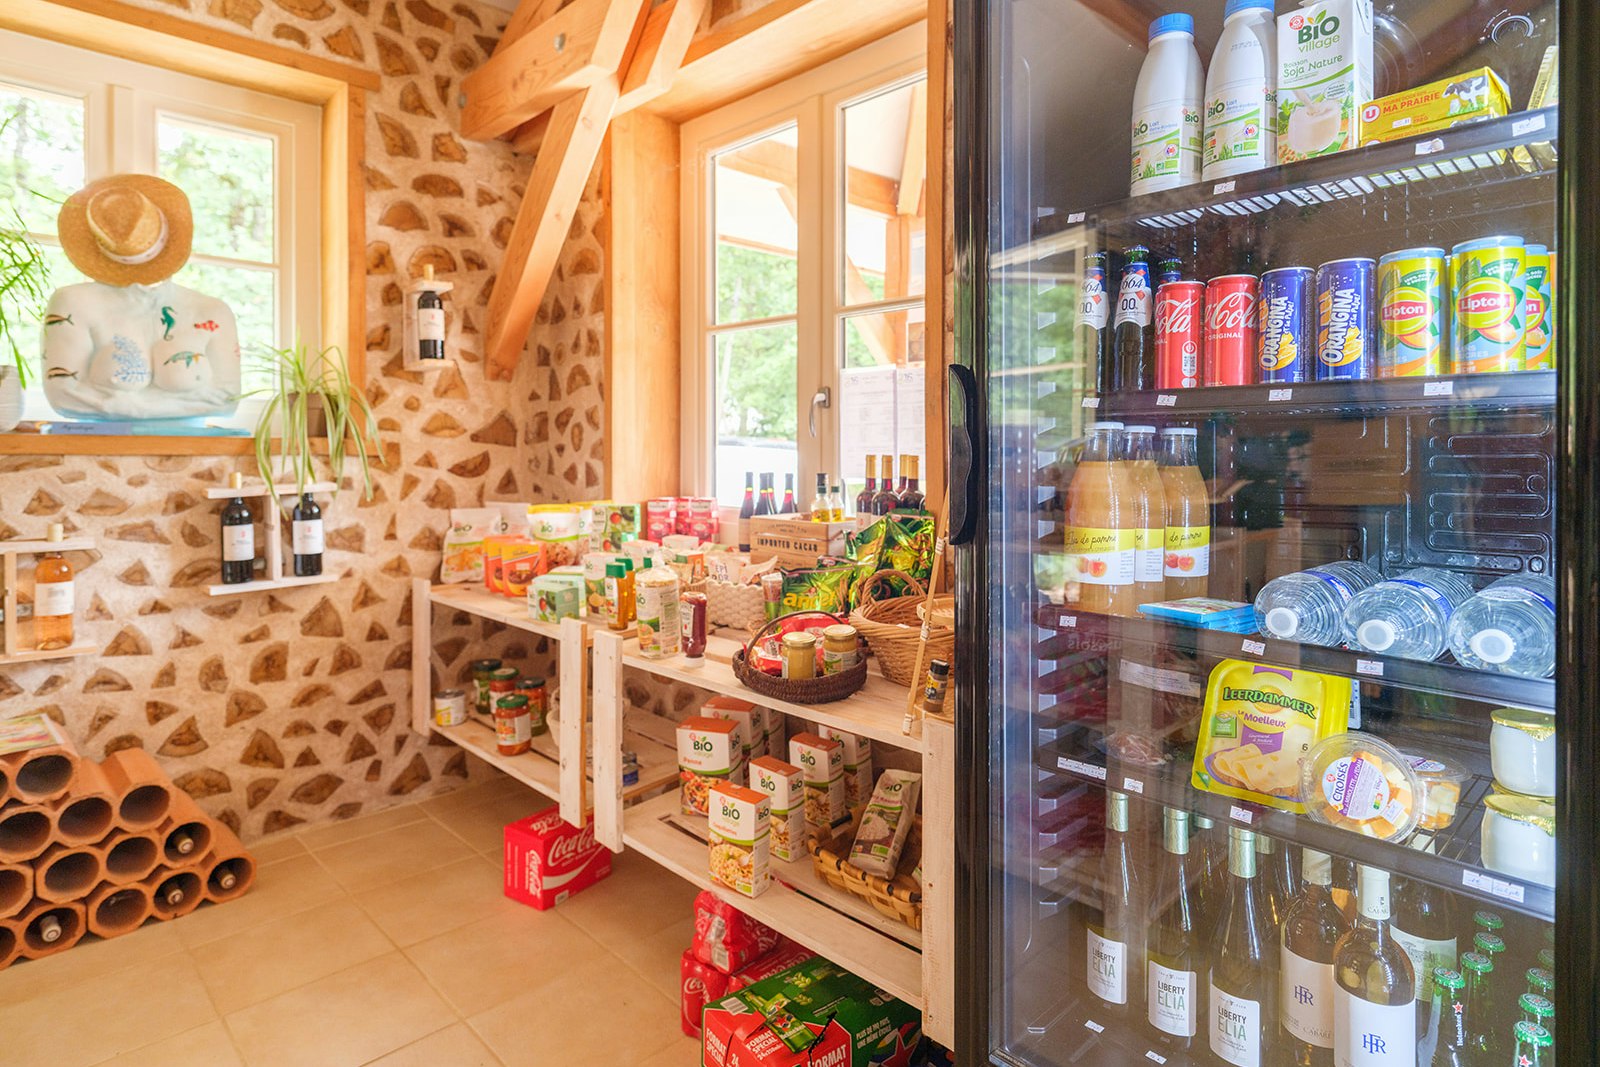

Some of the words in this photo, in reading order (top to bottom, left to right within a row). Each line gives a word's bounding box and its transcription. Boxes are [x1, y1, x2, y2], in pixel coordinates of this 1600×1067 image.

[1299, 34, 1340, 53] village
[1284, 67, 1305, 78] Soja
[1308, 54, 1343, 71] Nature
[1383, 104, 1398, 114] MA
[1401, 92, 1440, 109] PRAIRIE
[1384, 305, 1424, 319] Lipton
[1460, 296, 1508, 310] Lipton
[1260, 296, 1289, 368] ORANGINA
[1321, 288, 1355, 364] ORANGINA
[757, 538, 790, 549] IMPORTED
[794, 542, 818, 552] CACAO
[1080, 533, 1090, 545] de
[1223, 687, 1316, 720] LEERDAMMER
[1244, 713, 1286, 728] Moelleux
[1332, 762, 1348, 802] CROISÉS
[1092, 947, 1116, 963] LIBERTY
[1158, 980, 1186, 995] LIBERTY
[1218, 1006, 1246, 1024] LIBERTY
[1454, 1013, 1464, 1046] Heineken
[746, 1030, 774, 1050] FORMAT
[752, 1037, 778, 1053] SPECIAL
[732, 1053, 739, 1066] 24
